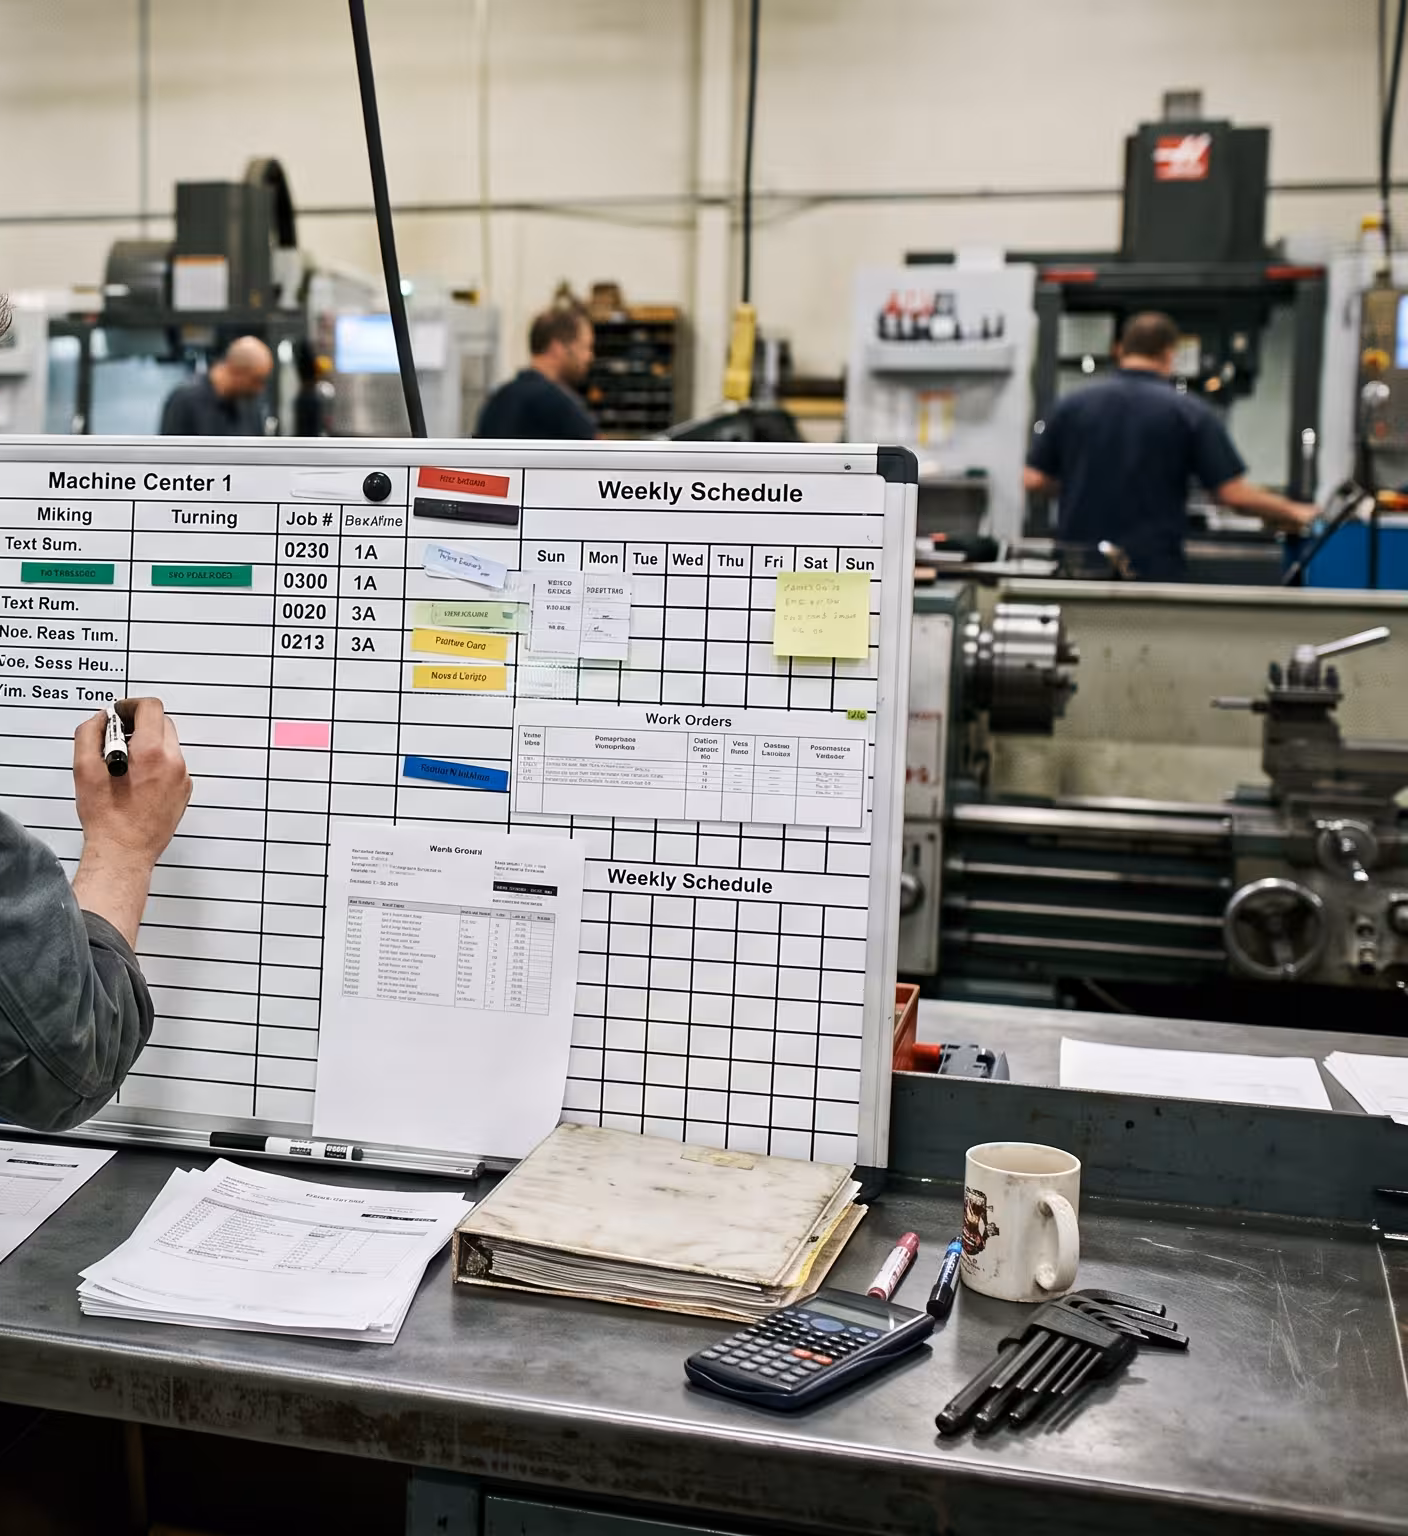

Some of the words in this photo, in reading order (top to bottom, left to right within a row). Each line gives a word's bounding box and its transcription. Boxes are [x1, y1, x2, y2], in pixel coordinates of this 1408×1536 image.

[49, 472, 136, 490] Machine
[144, 473, 215, 491] Center
[223, 475, 230, 491] 1
[598, 481, 682, 505] Weekly
[691, 482, 802, 502] Schedule
[38, 507, 92, 525] Miking
[171, 509, 237, 528] Turning
[286, 512, 317, 525] Job
[322, 513, 333, 526] #
[5, 537, 37, 550] Text
[43, 537, 81, 551] Sum.
[285, 542, 328, 558] 0230
[355, 545, 378, 559] 1A
[538, 550, 564, 562] Sun
[589, 551, 618, 564] Mon
[633, 553, 657, 565] Tue
[673, 554, 703, 566] Wed
[717, 555, 743, 567] Thu
[765, 556, 783, 568] Fri
[804, 557, 828, 569] Sat
[846, 558, 874, 570] Sun
[284, 573, 327, 589] 0300
[354, 575, 377, 590] 1A
[2, 596, 33, 609] Text
[39, 597, 78, 610] Rum.
[283, 603, 326, 619] 0020
[352, 606, 375, 621] 3A
[0, 625, 31, 638] Noe.
[37, 626, 75, 640] Reas
[282, 634, 324, 650] 0213
[352, 637, 375, 652] 3A
[35, 656, 72, 670] Sess
[32, 685, 68, 699] Seas
[75, 686, 117, 702] Tone.
[646, 713, 680, 725] Work
[685, 715, 731, 727] Orders
[608, 868, 676, 891] Weekly
[683, 873, 773, 893] Schedule
